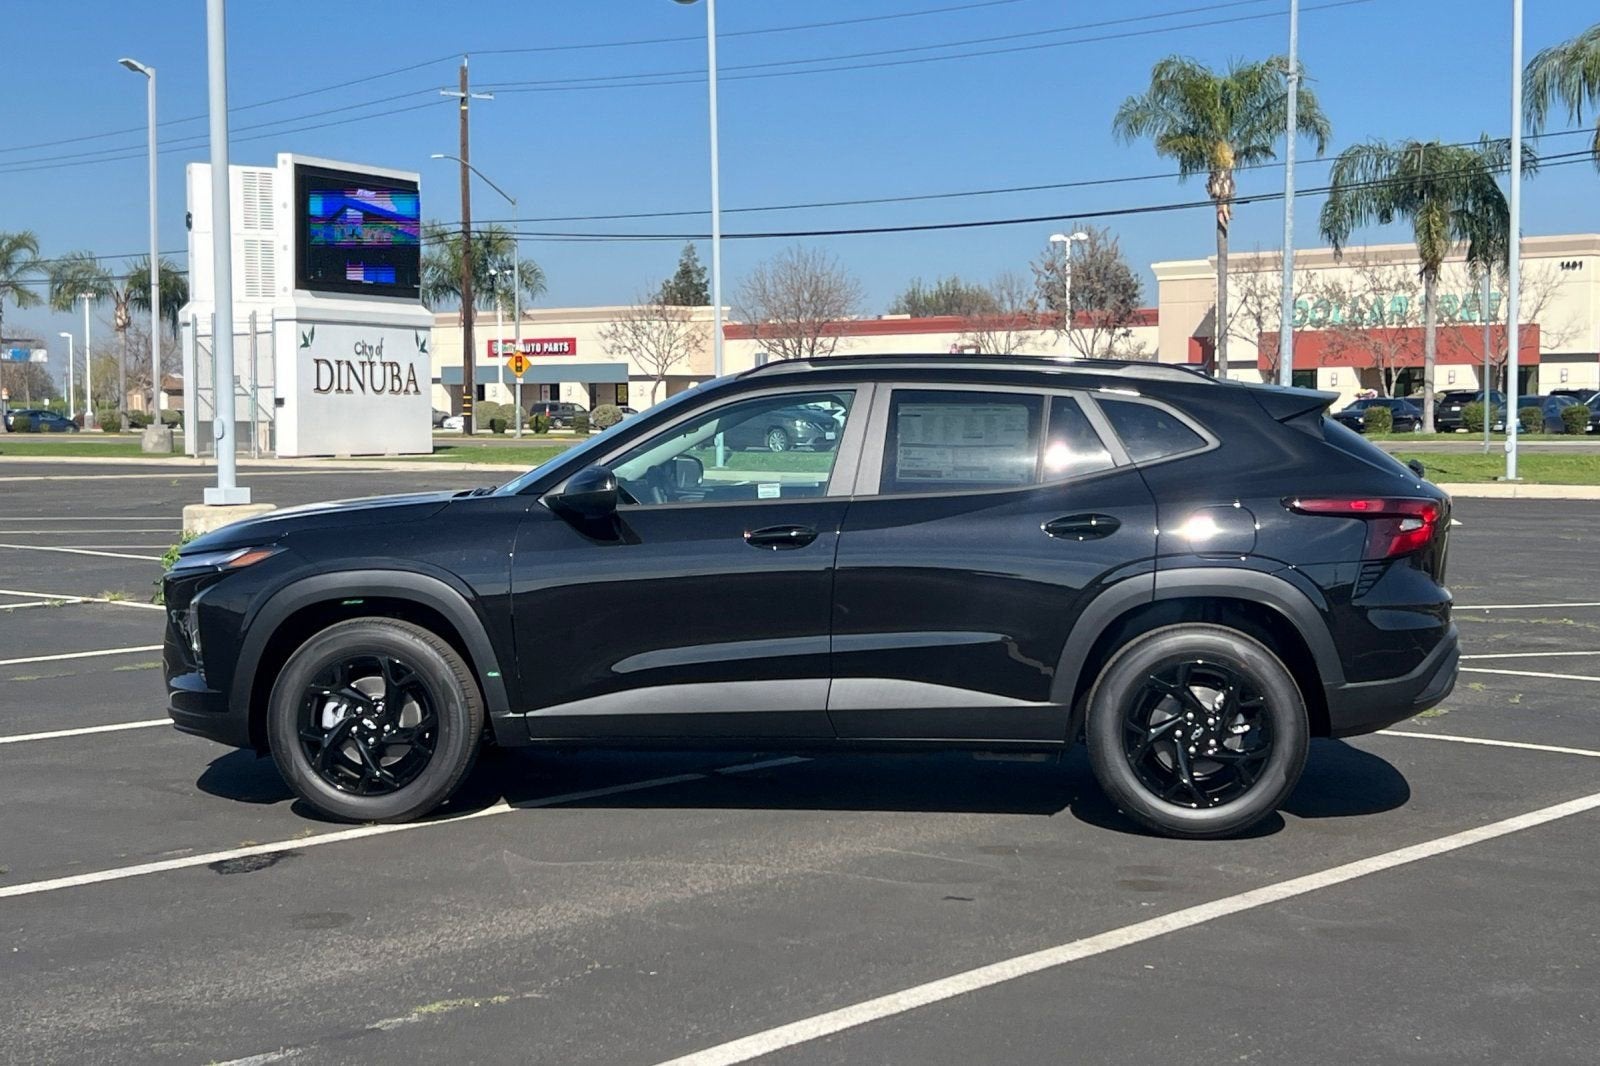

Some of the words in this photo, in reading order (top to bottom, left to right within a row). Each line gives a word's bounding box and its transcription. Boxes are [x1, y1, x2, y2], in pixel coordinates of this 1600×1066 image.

[354, 340, 374, 361] City
[375, 337, 384, 361] of
[516, 342, 541, 354] AUTO
[543, 341, 570, 353] PARTS
[313, 358, 422, 395] DINUBA
